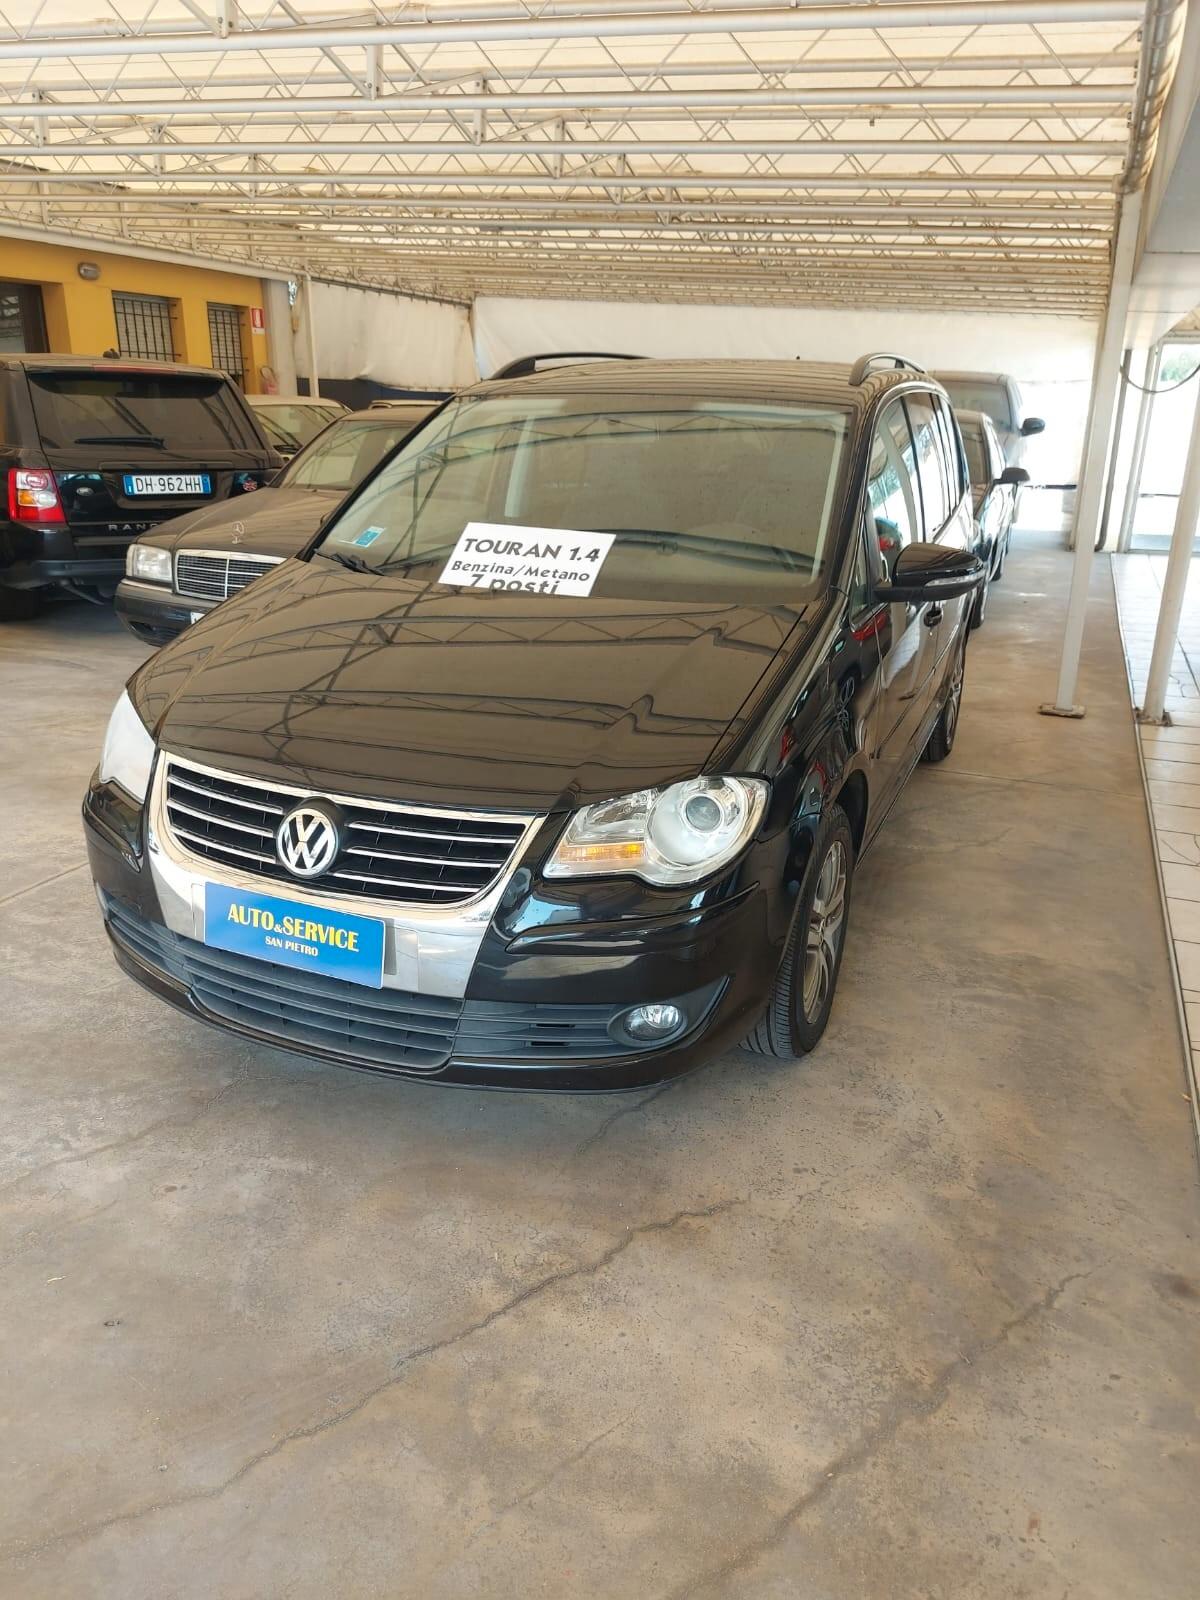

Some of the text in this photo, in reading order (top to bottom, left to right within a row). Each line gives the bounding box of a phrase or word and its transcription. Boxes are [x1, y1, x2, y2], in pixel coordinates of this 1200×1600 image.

[464, 538, 601, 563] TOURAN 1.4
[451, 560, 591, 582] Benzina/Metano
[470, 573, 561, 595] 7 posti
[265, 935, 319, 957] SAN PIETRO
